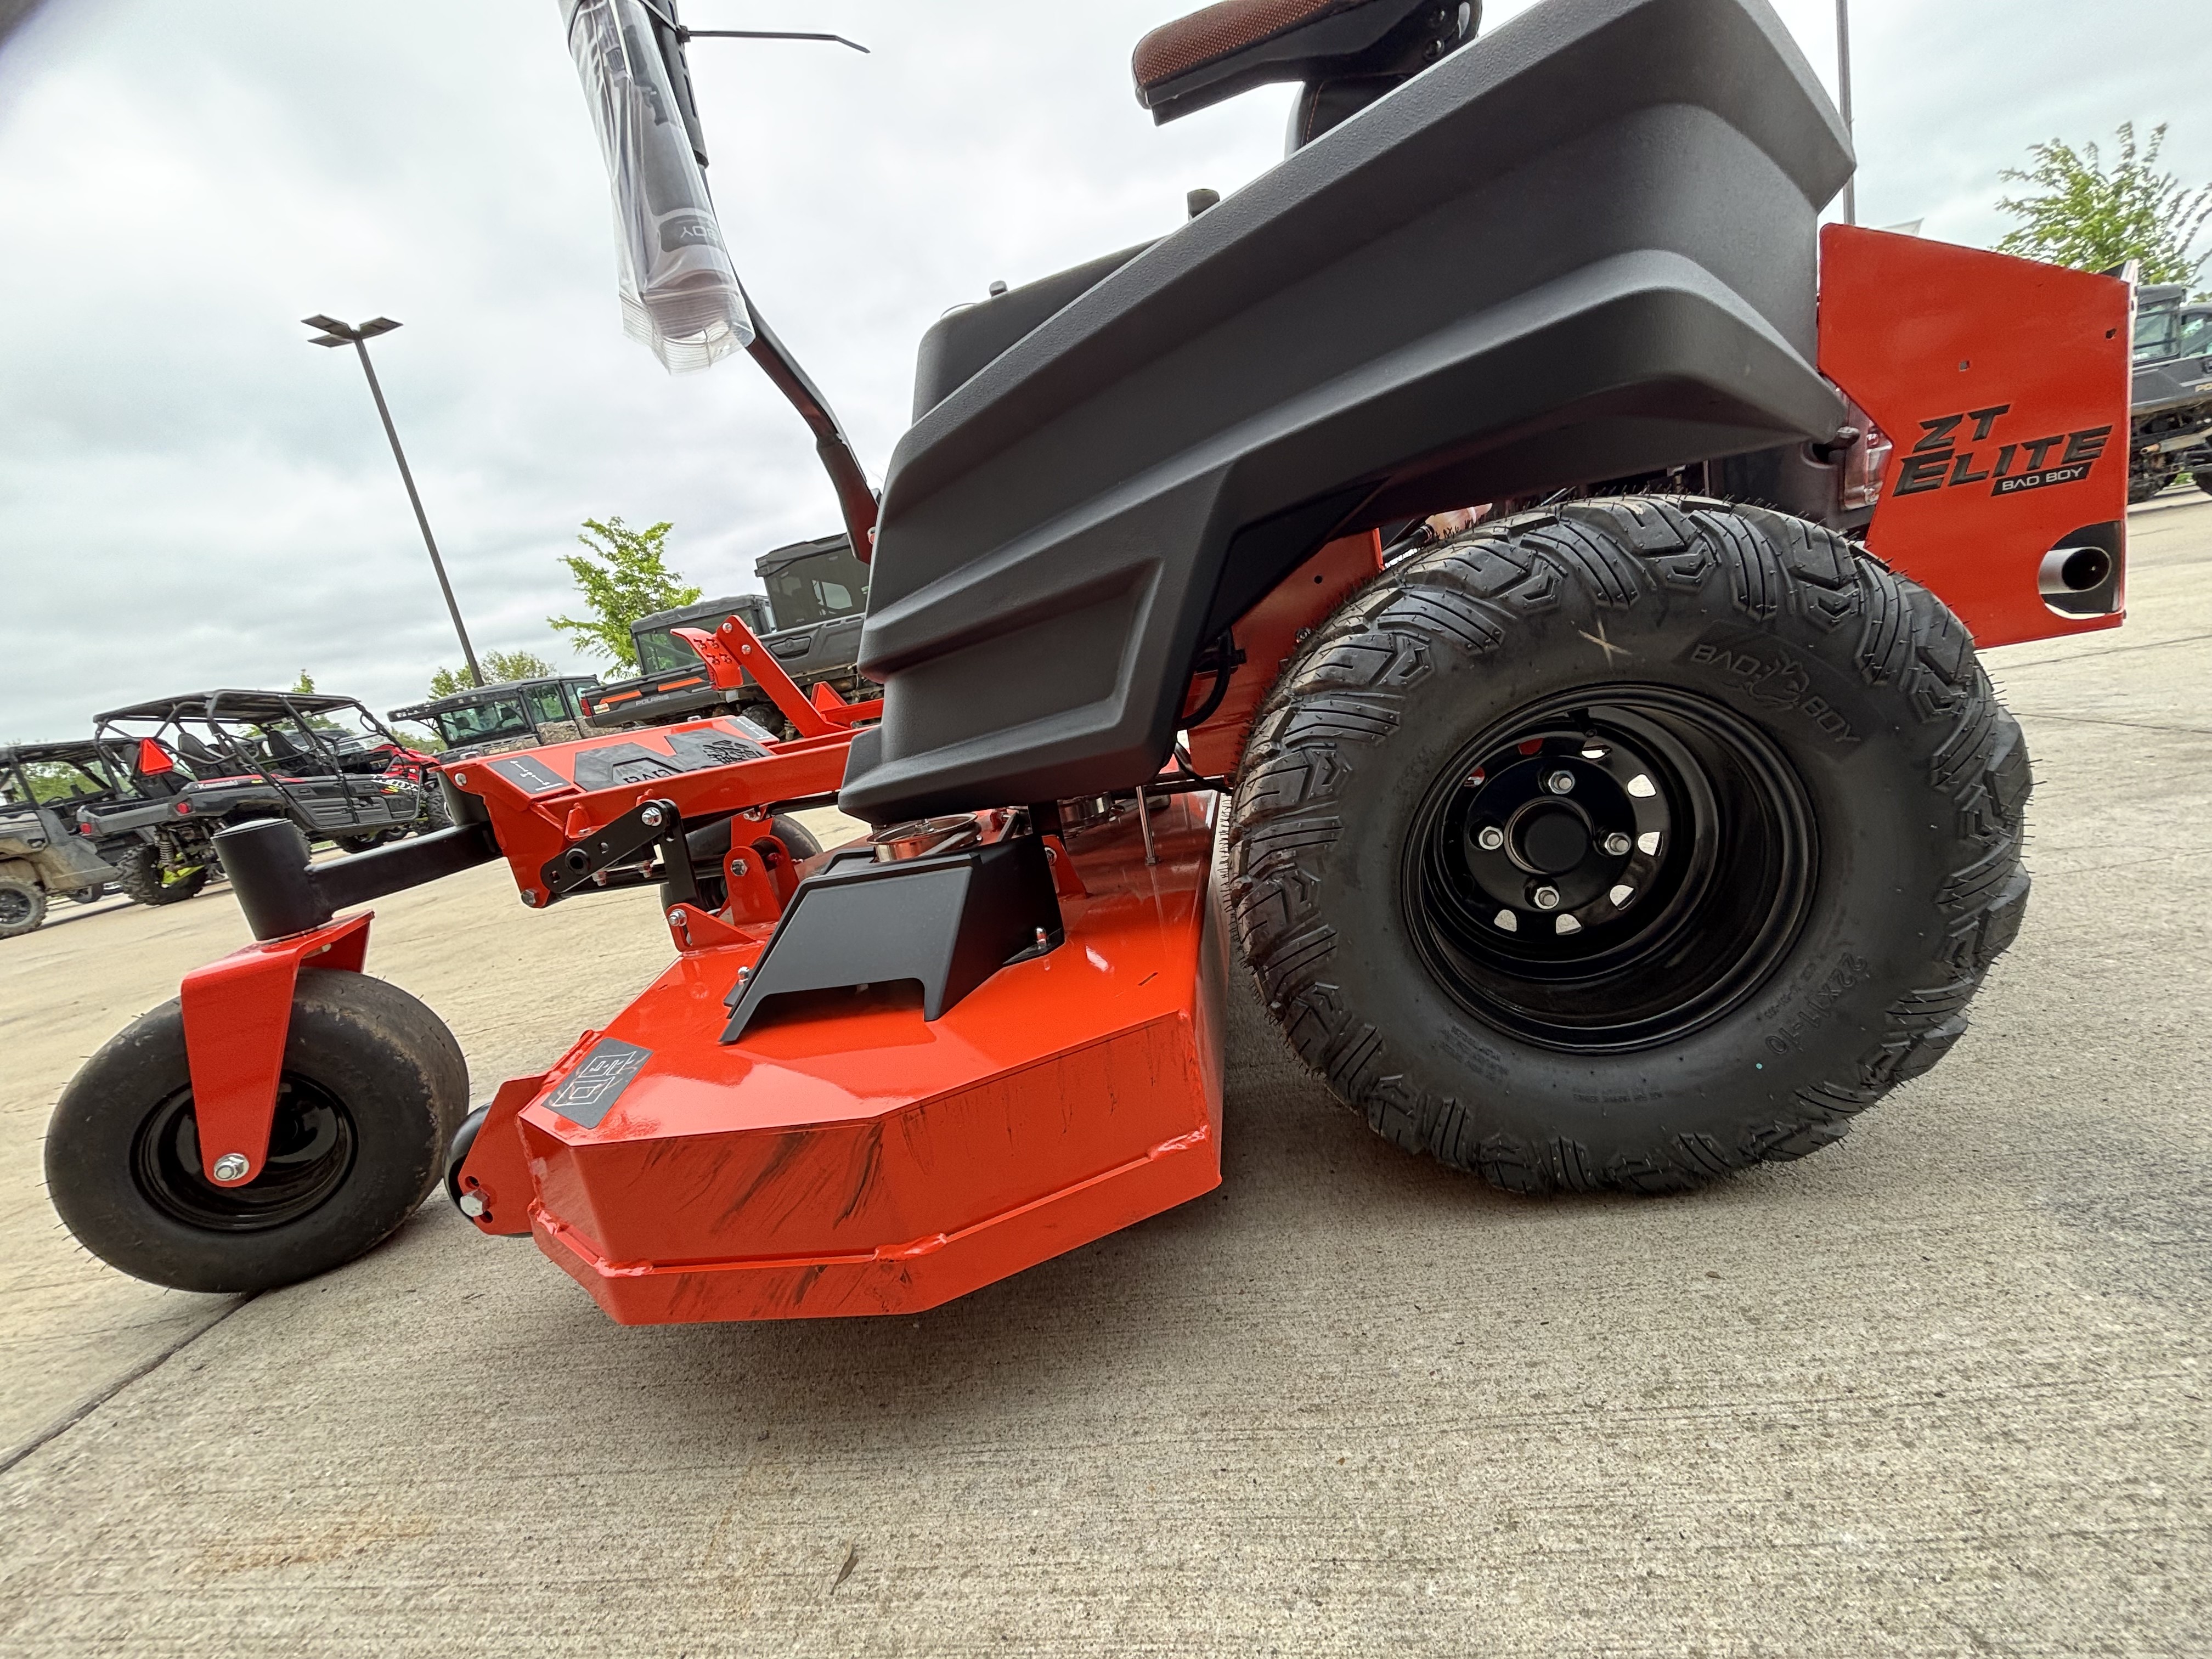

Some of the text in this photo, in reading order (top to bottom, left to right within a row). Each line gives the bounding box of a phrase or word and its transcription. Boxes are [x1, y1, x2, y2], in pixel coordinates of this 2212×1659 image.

[1912, 405, 2011, 454] ZT
[1893, 426, 2112, 496] ELITE
[2002, 467, 2083, 491] BAD BOY
[636, 694, 669, 706] POLARIS
[1690, 644, 1861, 742] BAD BOY
